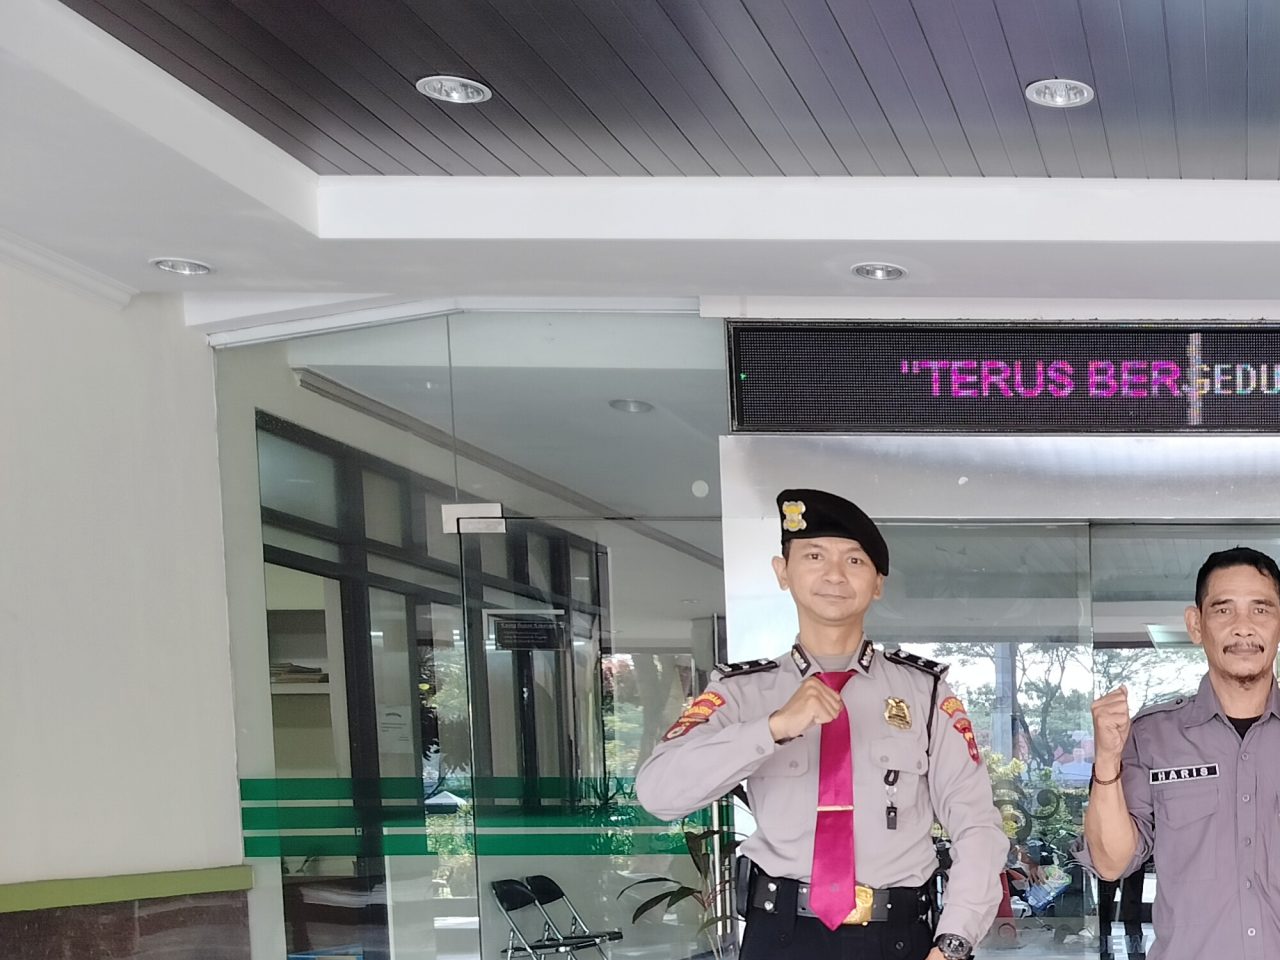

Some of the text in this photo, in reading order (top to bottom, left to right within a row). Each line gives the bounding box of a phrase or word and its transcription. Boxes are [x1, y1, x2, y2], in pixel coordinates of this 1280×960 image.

[900, 359, 1075, 397] "TERUS
[1088, 359, 1186, 397] BER
[1157, 767, 1209, 781] HARIS
